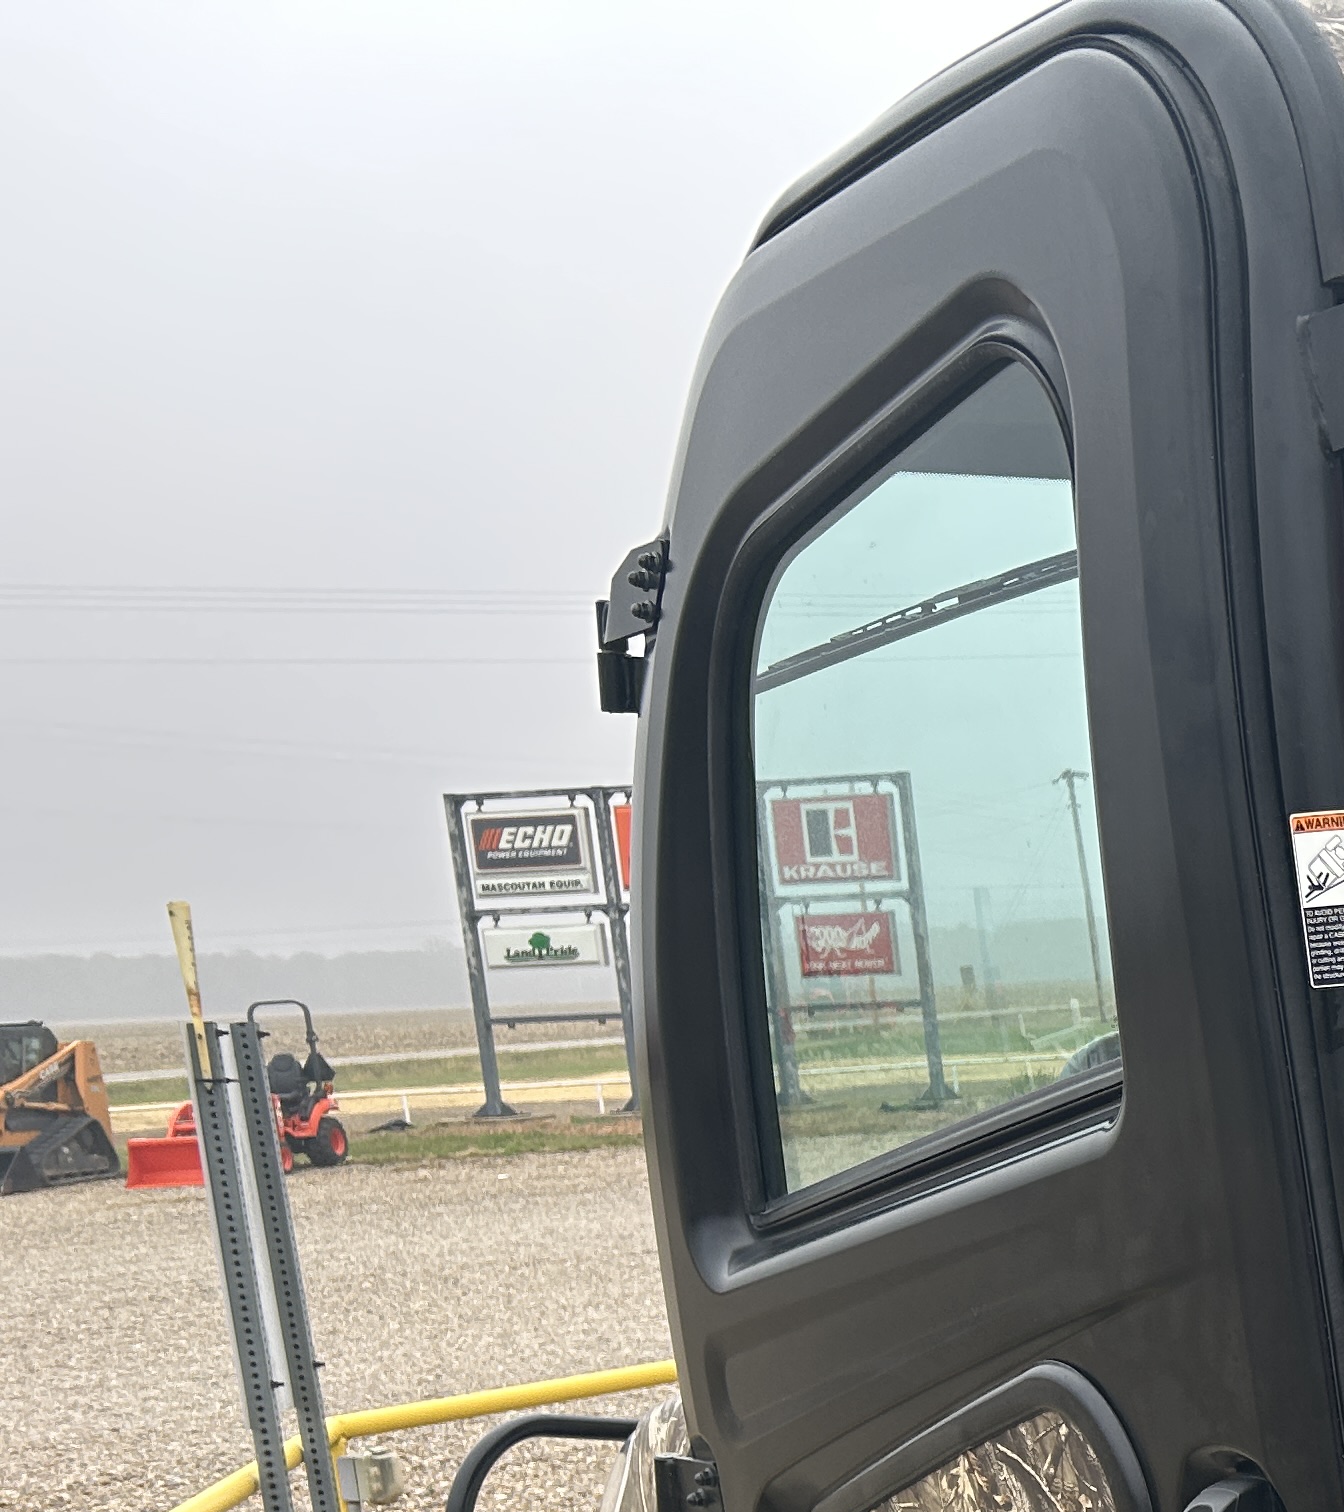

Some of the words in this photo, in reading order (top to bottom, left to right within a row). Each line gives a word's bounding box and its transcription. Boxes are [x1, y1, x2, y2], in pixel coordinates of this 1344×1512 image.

[499, 824, 573, 849] ECHO
[783, 860, 888, 880] KRAUSE
[481, 880, 546, 892] MASCOUTAH
